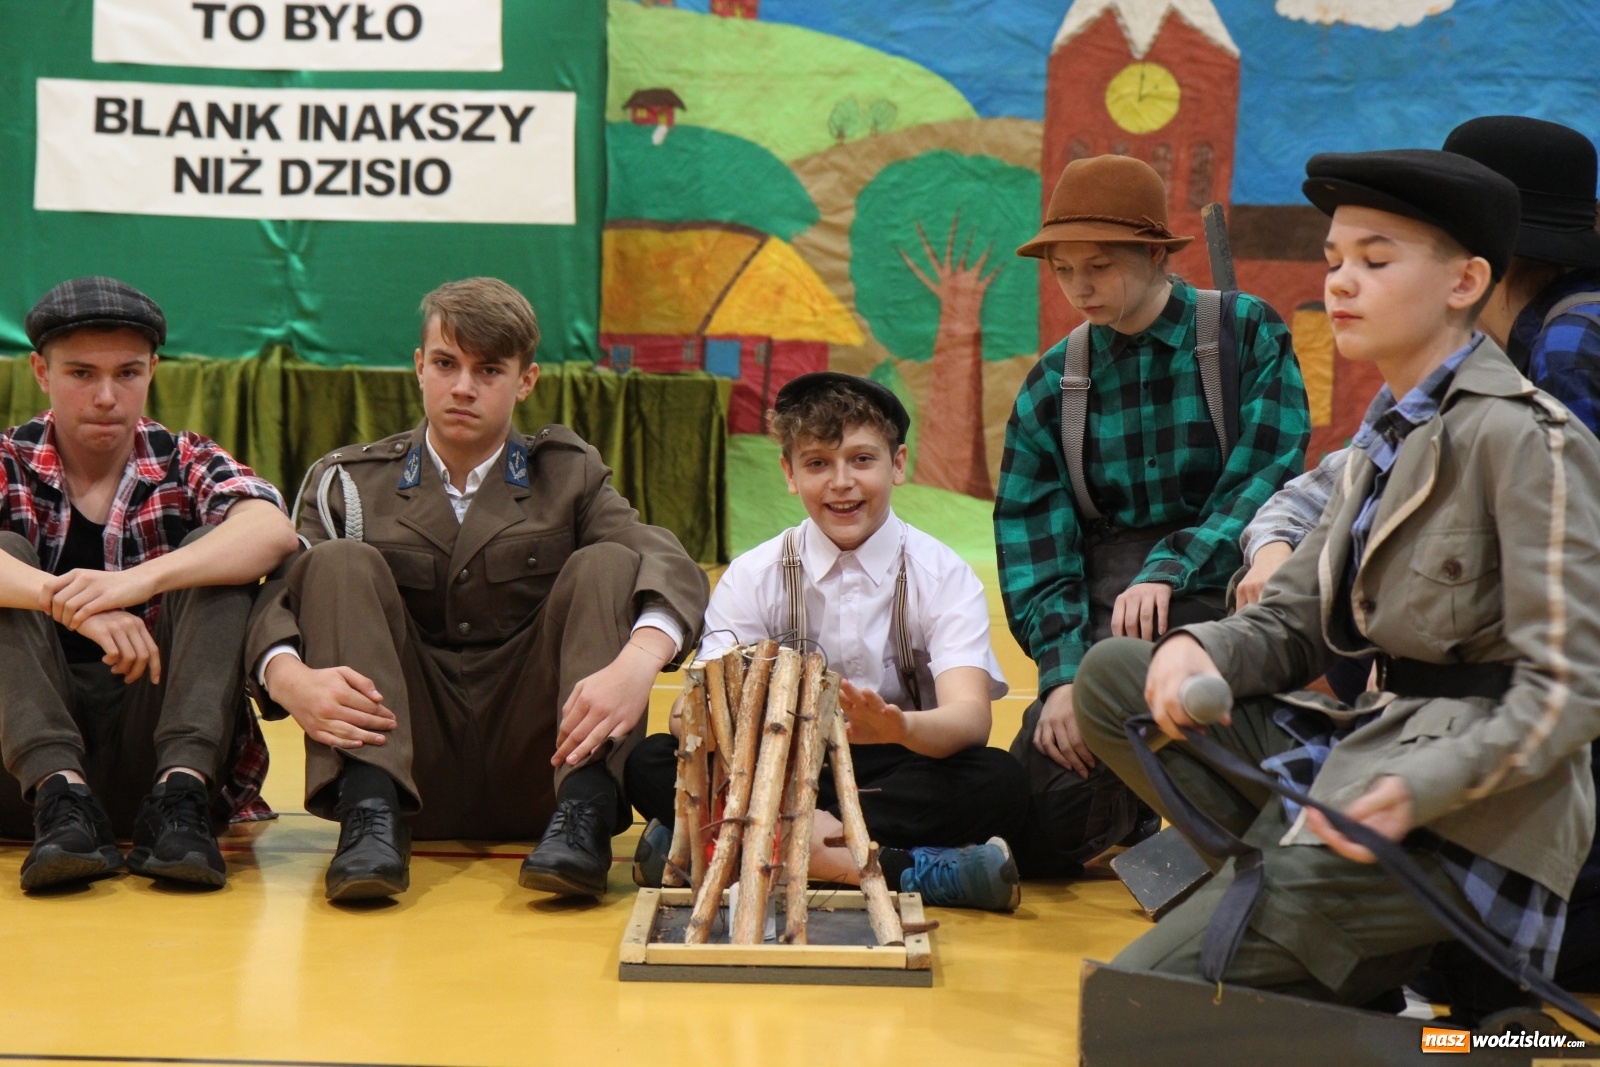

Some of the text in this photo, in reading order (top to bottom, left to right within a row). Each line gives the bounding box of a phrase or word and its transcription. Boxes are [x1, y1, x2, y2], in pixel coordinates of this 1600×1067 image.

[192, 2, 422, 41] TO BYŁO
[94, 97, 534, 142] BLANK INAKSZY
[173, 149, 452, 196] NIŻ DZISIO
